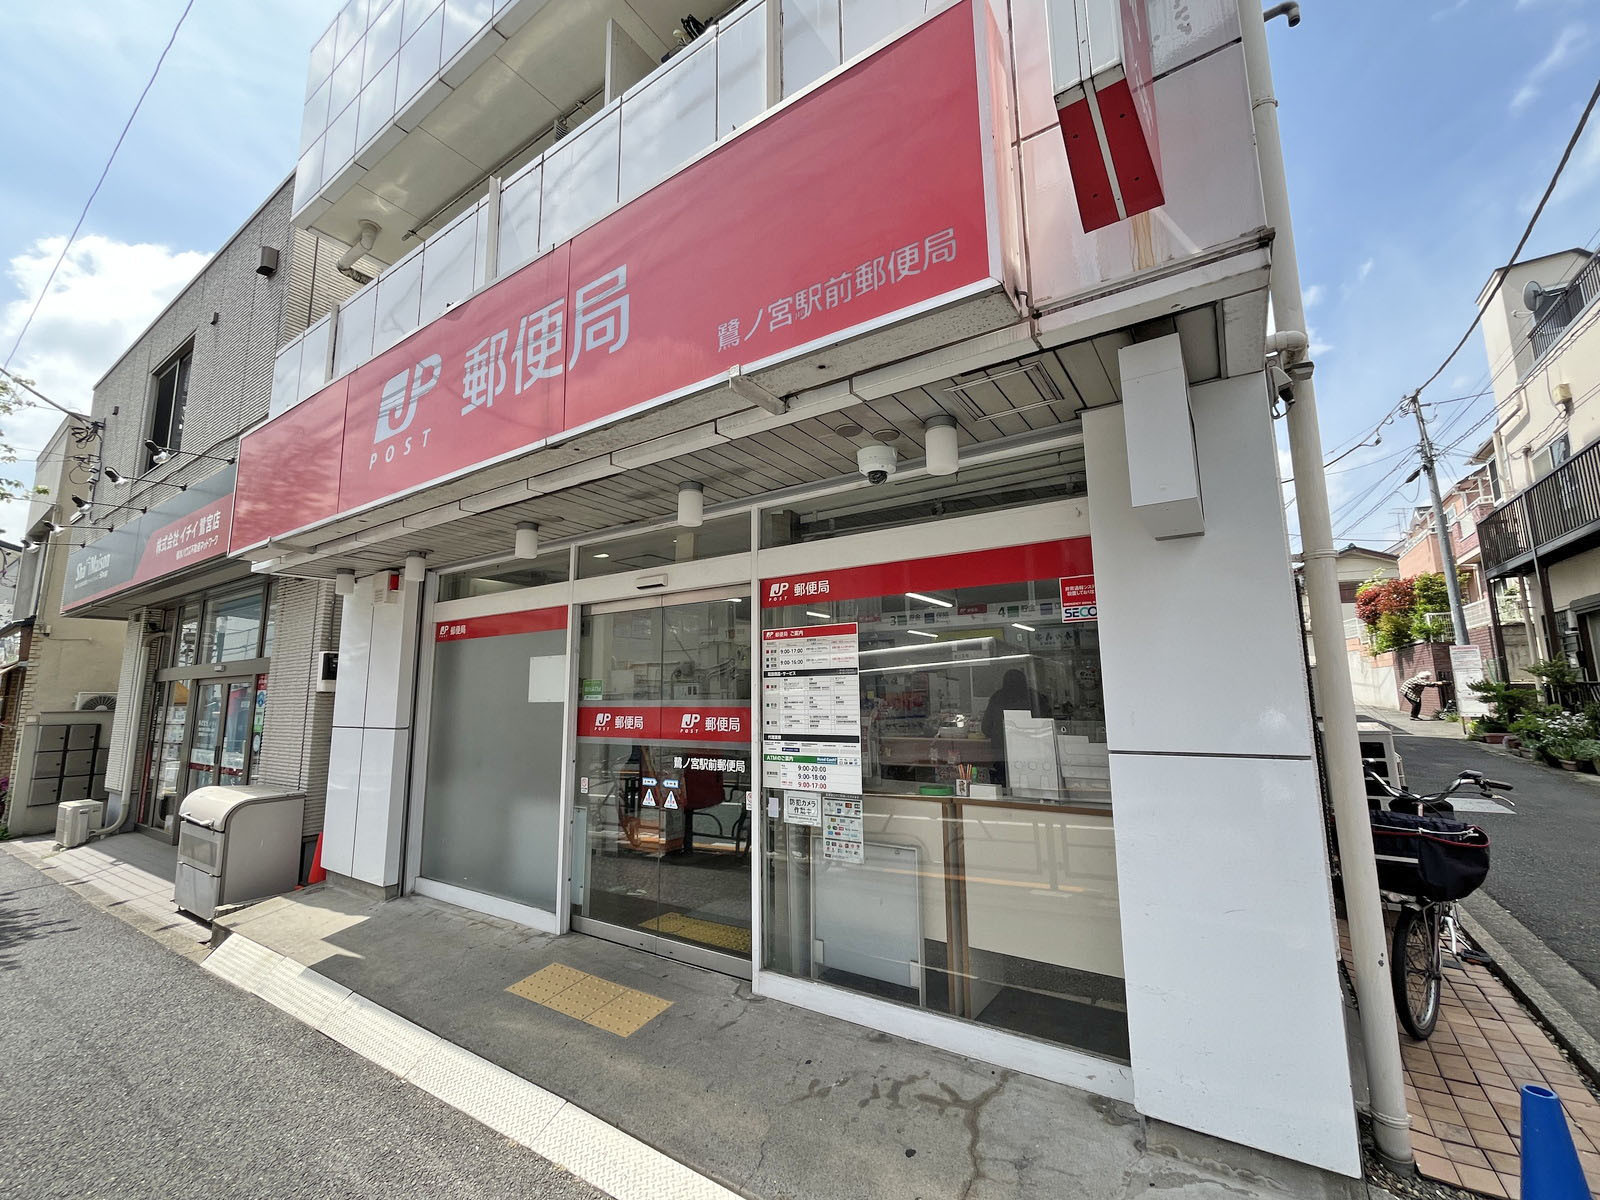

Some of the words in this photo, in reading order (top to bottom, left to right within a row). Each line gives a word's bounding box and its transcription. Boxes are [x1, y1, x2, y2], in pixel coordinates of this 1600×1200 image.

[717, 227, 957, 352] 鷺ノ宮駅前郵便局
[461, 263, 630, 416] 郵便局
[369, 428, 431, 470] POST
[794, 580, 830, 597] 郵便局
[997, 606, 1006, 617] 4
[1064, 606, 1098, 618] SECO
[890, 615, 897, 626] 3
[614, 715, 644, 730] 郵便局
[704, 716, 741, 733] 郵便局
[797, 764, 827, 773] 9:00-20:00
[797, 773, 827, 781] 9:00-18:00
[797, 781, 827, 790] 9:00-17:00
[789, 798, 816, 808] 防犯カメラ
